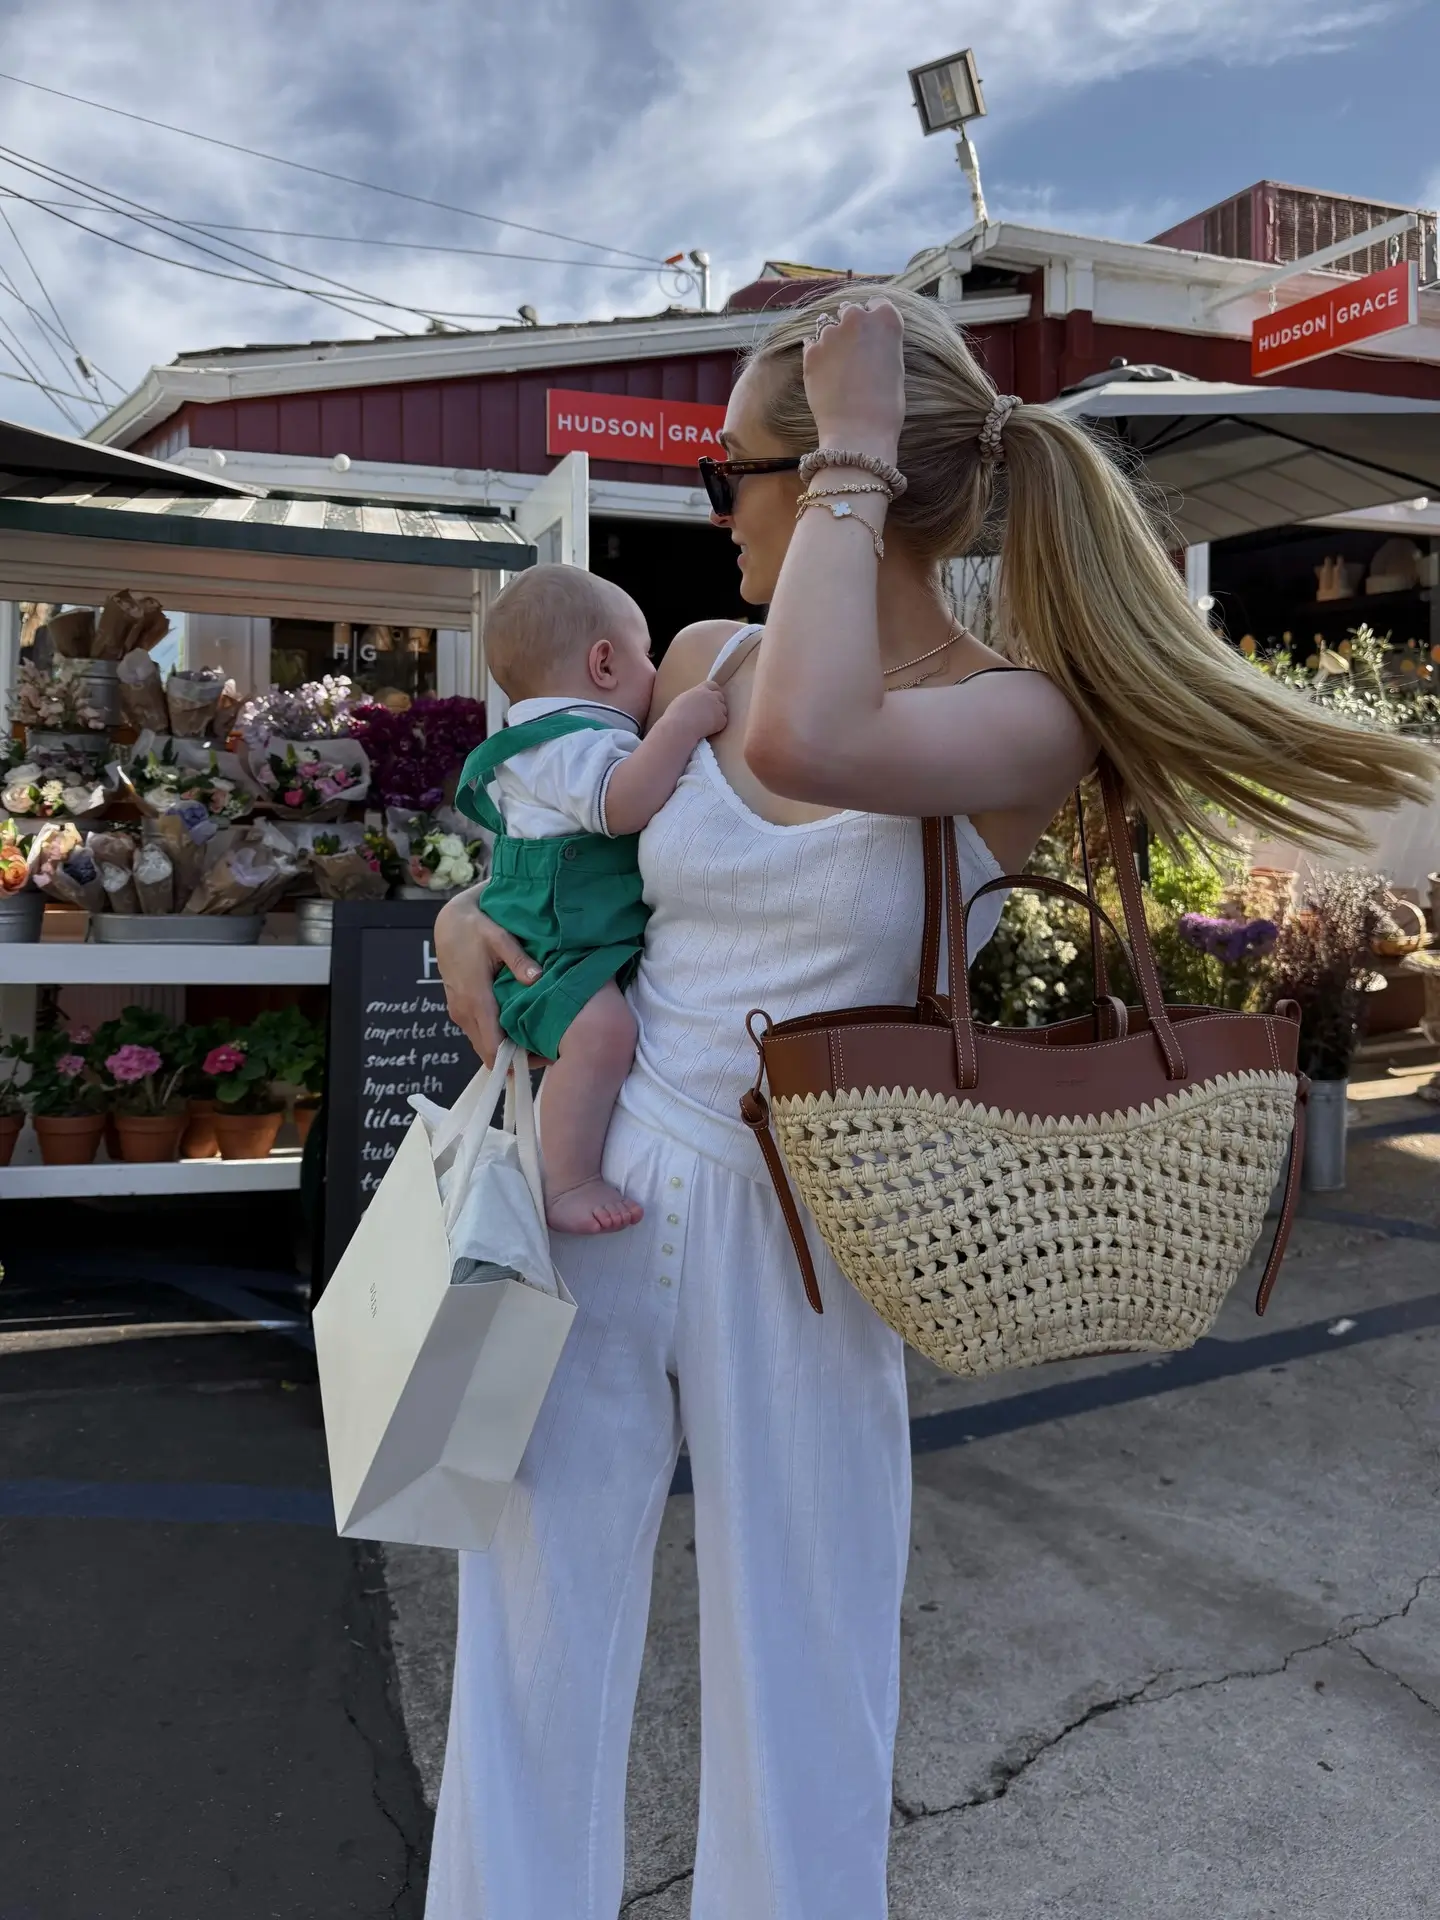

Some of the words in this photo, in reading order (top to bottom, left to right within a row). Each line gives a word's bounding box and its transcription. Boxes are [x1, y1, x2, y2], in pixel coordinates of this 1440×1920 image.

[1258, 314, 1327, 353] HUDSON
[1336, 288, 1399, 324] GRACE
[557, 413, 655, 439] HUDSON
[668, 424, 724, 445] GRAC
[366, 996, 420, 1013] mixed
[420, 997, 448, 1012] bou
[364, 1021, 437, 1046] imported
[442, 1021, 466, 1038] tu
[364, 1048, 416, 1068] sweet
[421, 1052, 460, 1071] peas
[363, 1075, 443, 1103] hyacinth
[361, 1141, 396, 1161] tub
